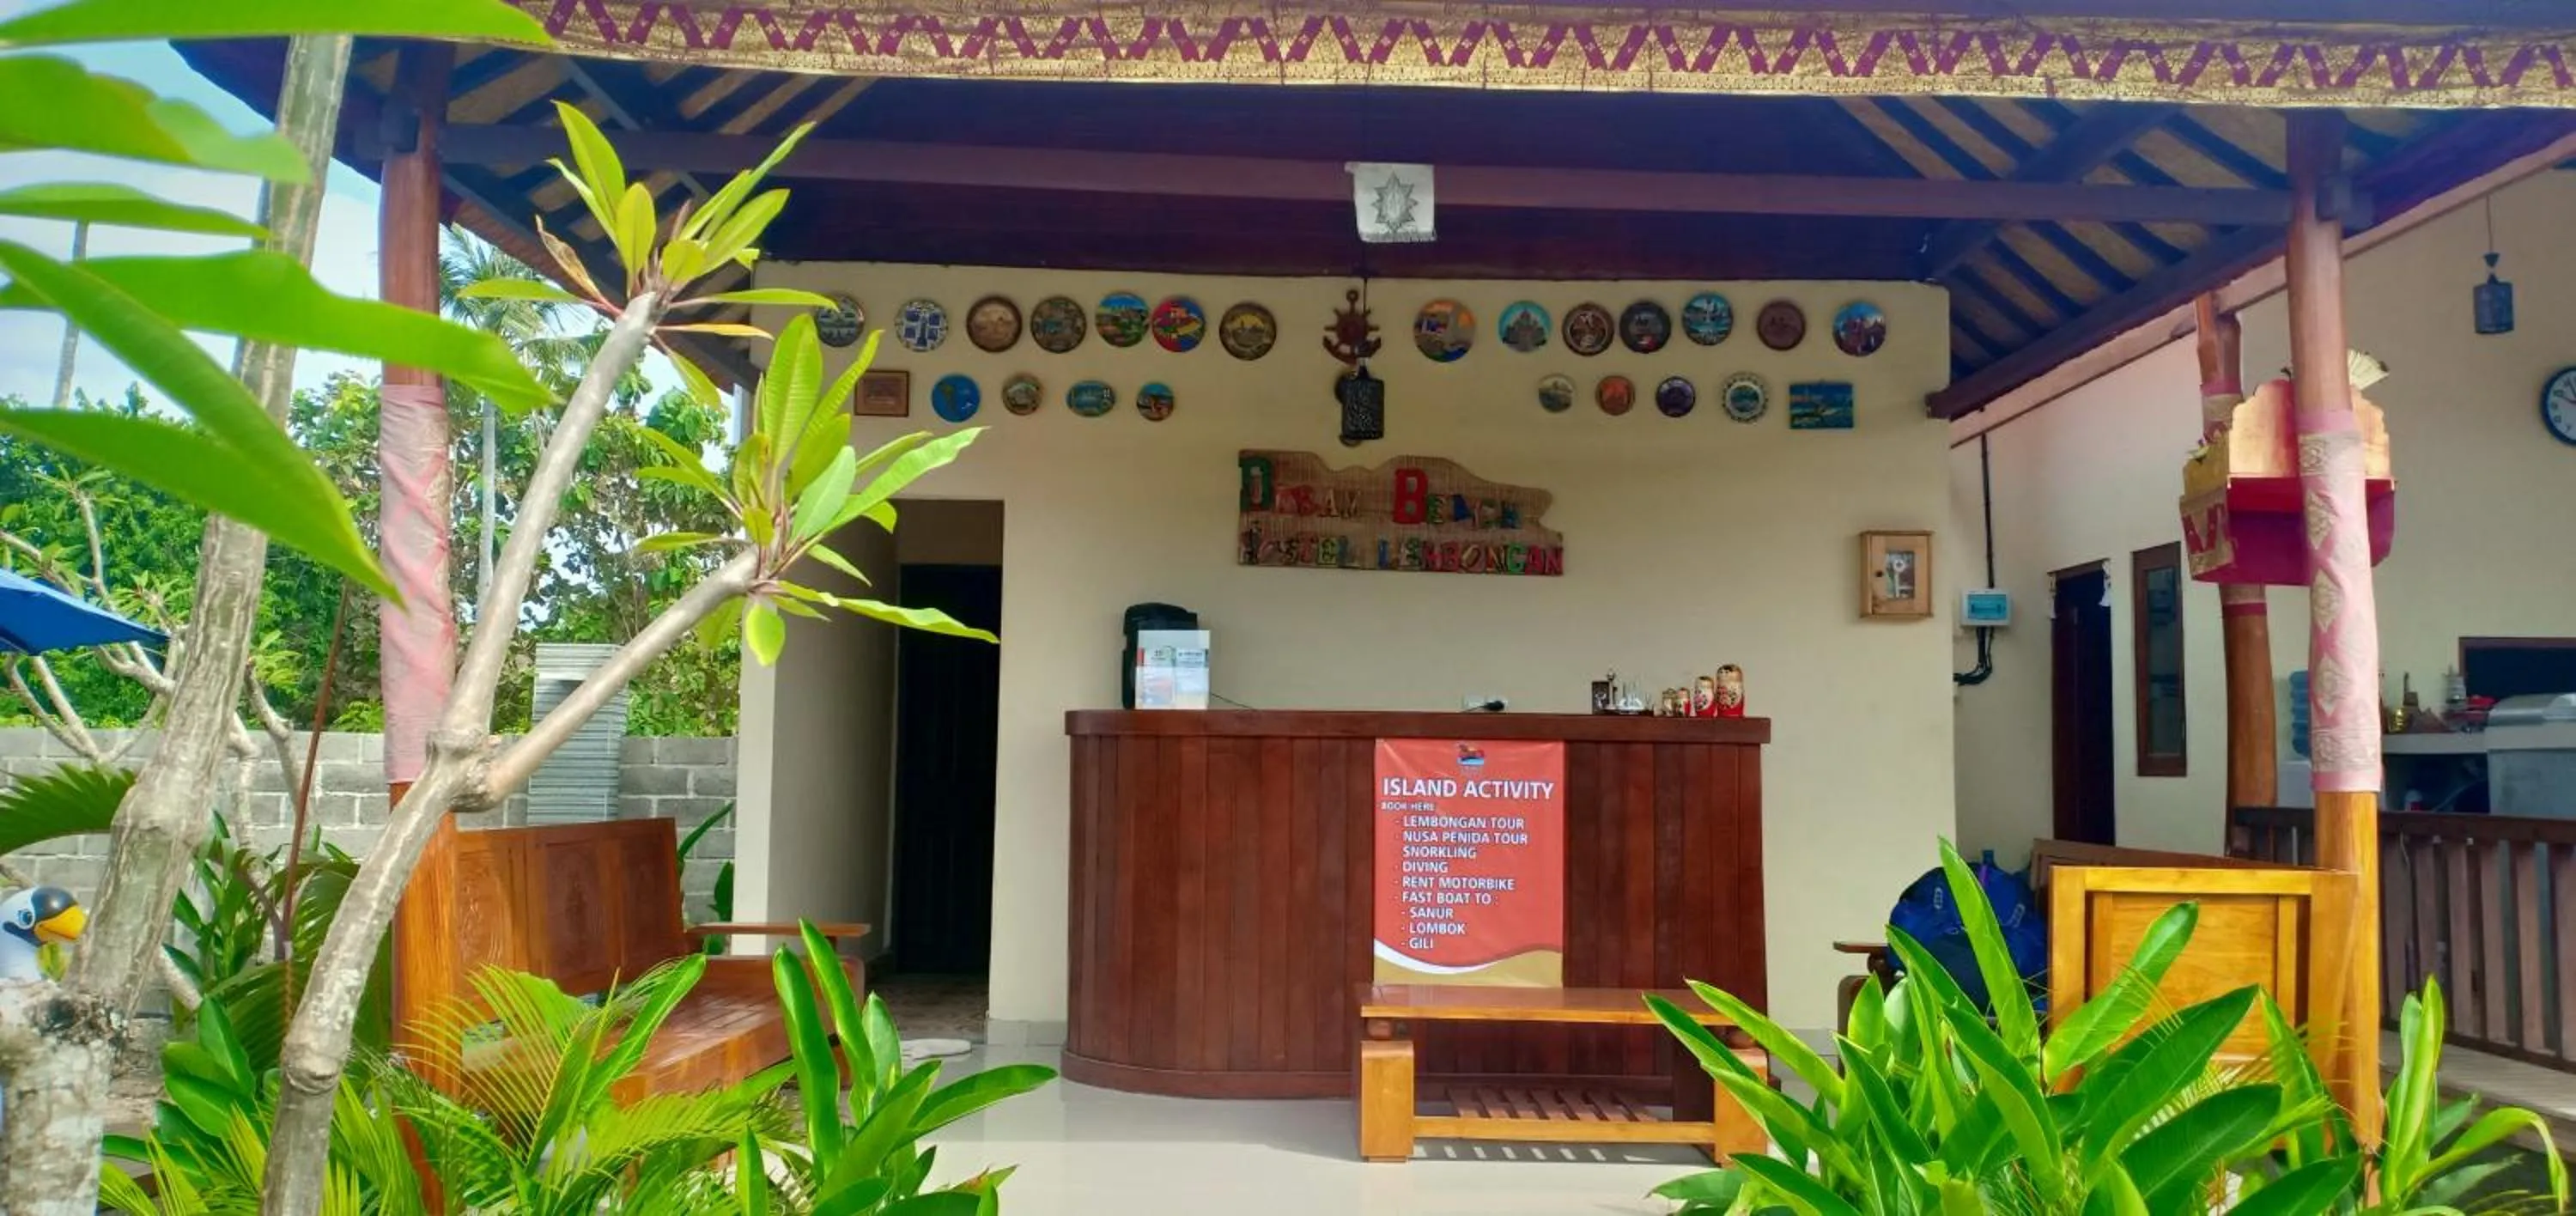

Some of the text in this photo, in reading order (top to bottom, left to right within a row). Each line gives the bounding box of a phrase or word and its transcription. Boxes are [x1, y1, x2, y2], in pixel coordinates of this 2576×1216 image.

[1382, 778, 1554, 800] ISLAND ACTIVITY
[1411, 802, 1436, 812] HERE
[1403, 816, 1524, 830] LEMBONGAN TOUR
[1403, 831, 1528, 845] NUSA PENIDA TOUR
[1402, 846, 1477, 859] SNORKLING
[1402, 861, 1449, 873] DIVING
[1402, 877, 1516, 891] RENT MOTORBIKE
[1401, 891, 1492, 905] FAST BOAT TO
[1409, 907, 1454, 919] SANUR
[1409, 922, 1466, 935] LOMBOK
[1409, 938, 1434, 949] GILI
